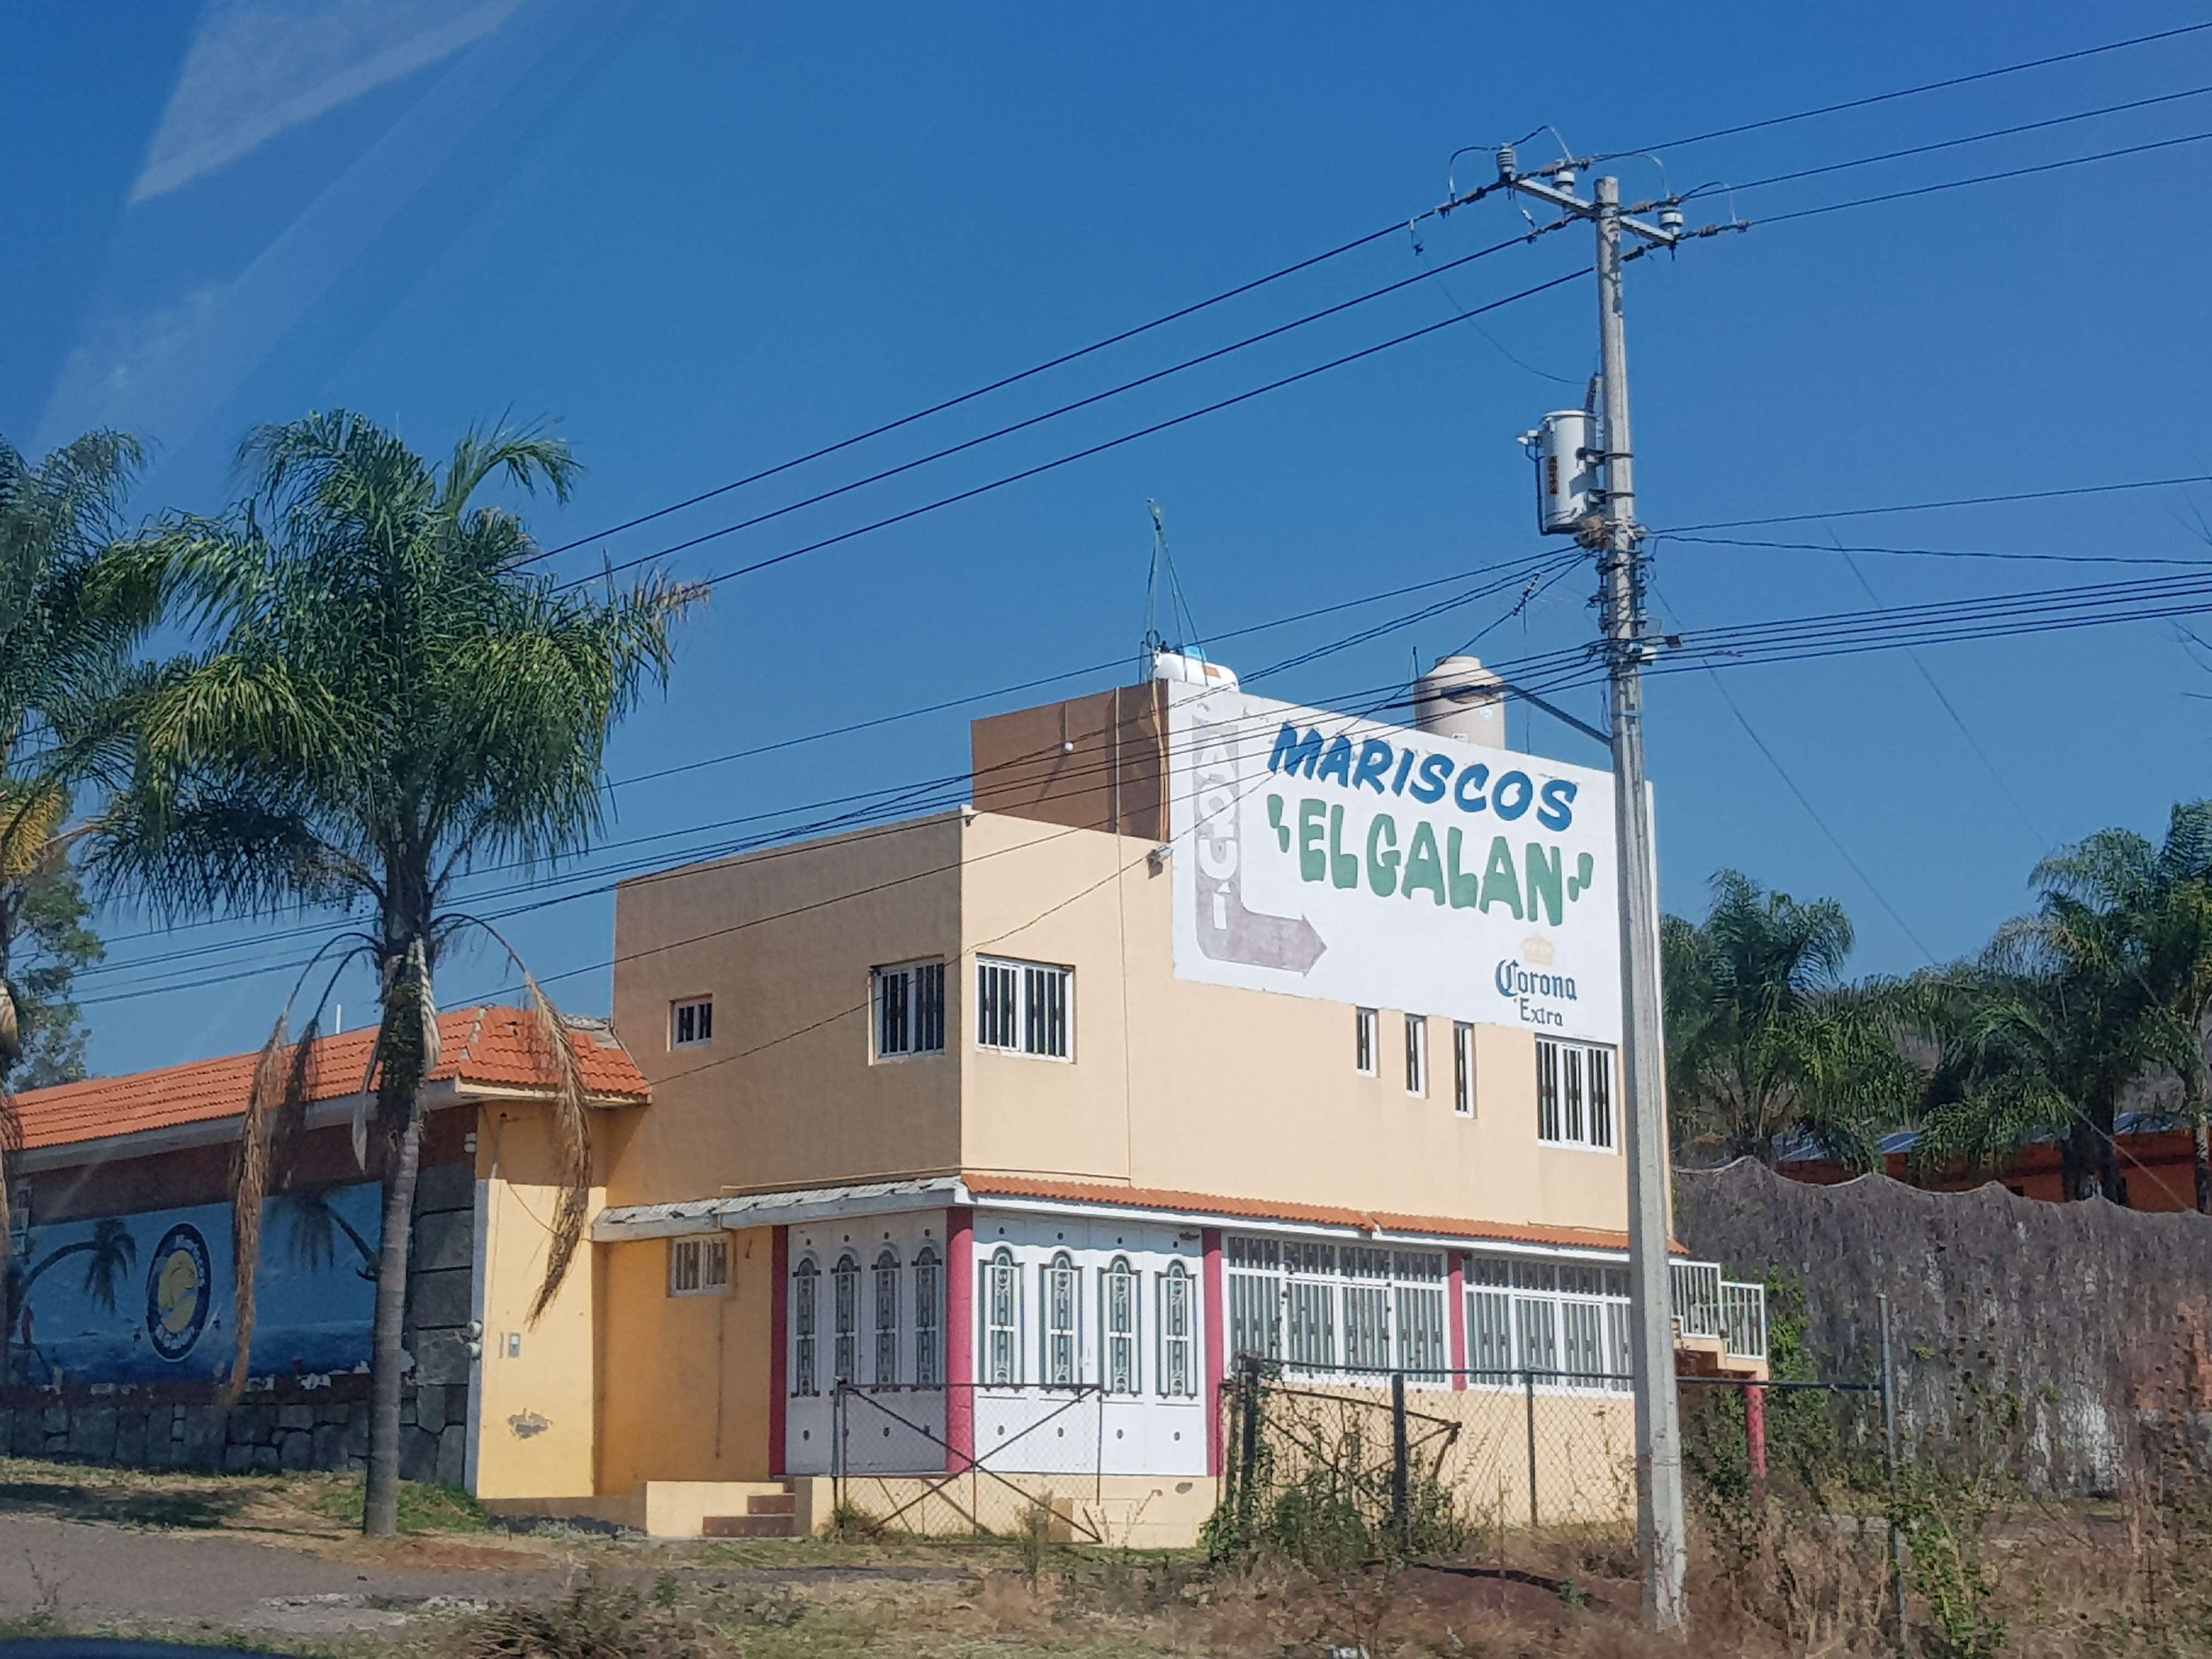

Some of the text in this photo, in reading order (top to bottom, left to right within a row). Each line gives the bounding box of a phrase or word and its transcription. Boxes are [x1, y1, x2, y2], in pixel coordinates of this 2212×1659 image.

[1267, 721, 1578, 832] MARISCOS
[1494, 959, 1577, 1001] Corona
[1519, 997, 1564, 1027] Extra
